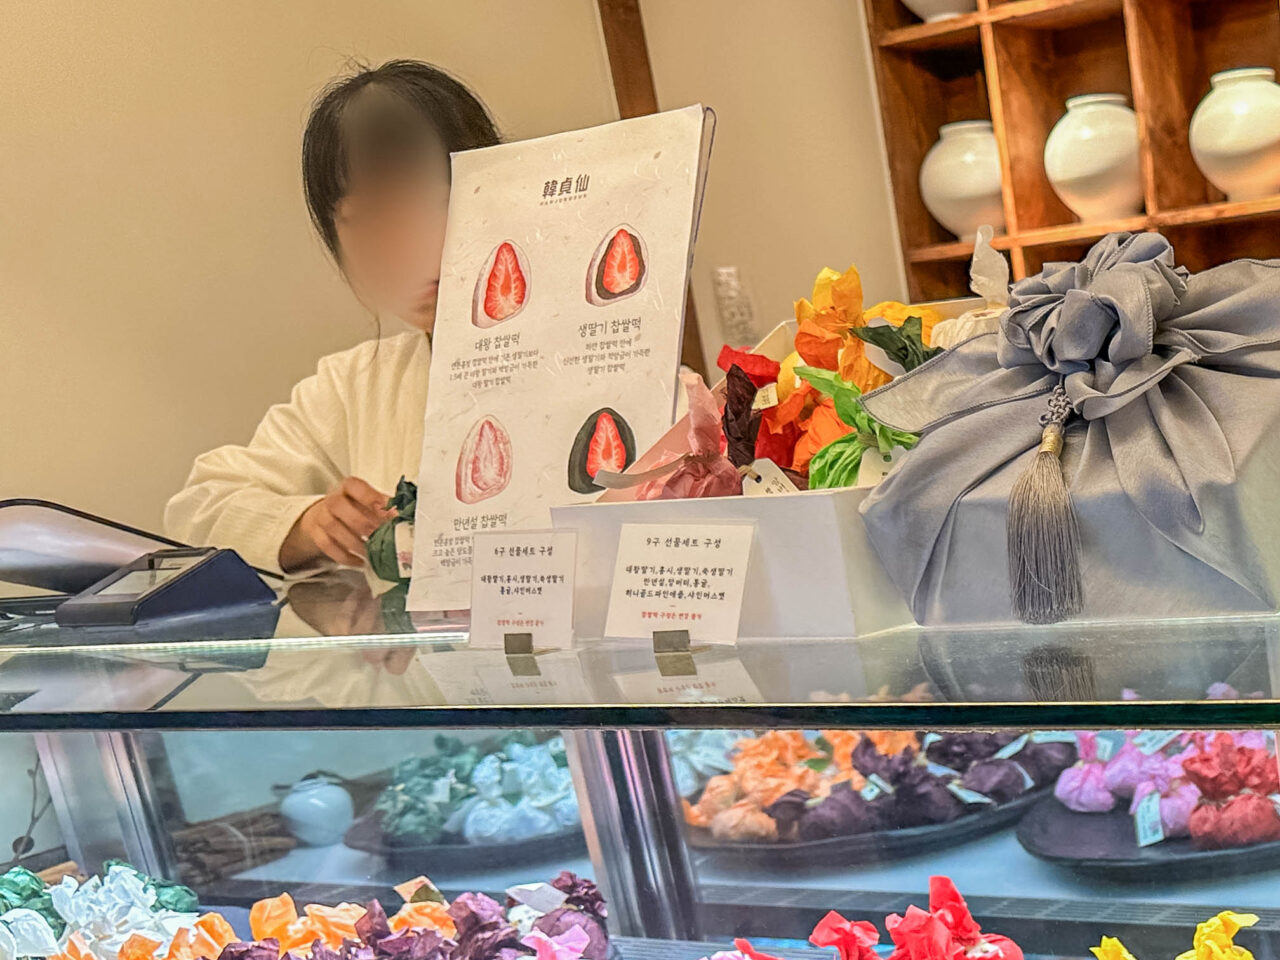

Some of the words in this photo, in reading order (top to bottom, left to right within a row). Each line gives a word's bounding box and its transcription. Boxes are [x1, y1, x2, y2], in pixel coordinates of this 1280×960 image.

[542, 174, 590, 199] 韓貞仙
[578, 320, 607, 338] 생딸기
[611, 316, 641, 334] 찹쌀떡
[494, 332, 520, 349] 찹쌀떡
[453, 516, 478, 531] 만년설
[481, 513, 507, 529] 찹쌀떡
[494, 546, 505, 557] 6구
[509, 546, 536, 557] 선물세트
[539, 546, 553, 556] 구성
[646, 537, 660, 547] 9구
[664, 537, 699, 548] 선물세트
[704, 538, 722, 549] 구성
